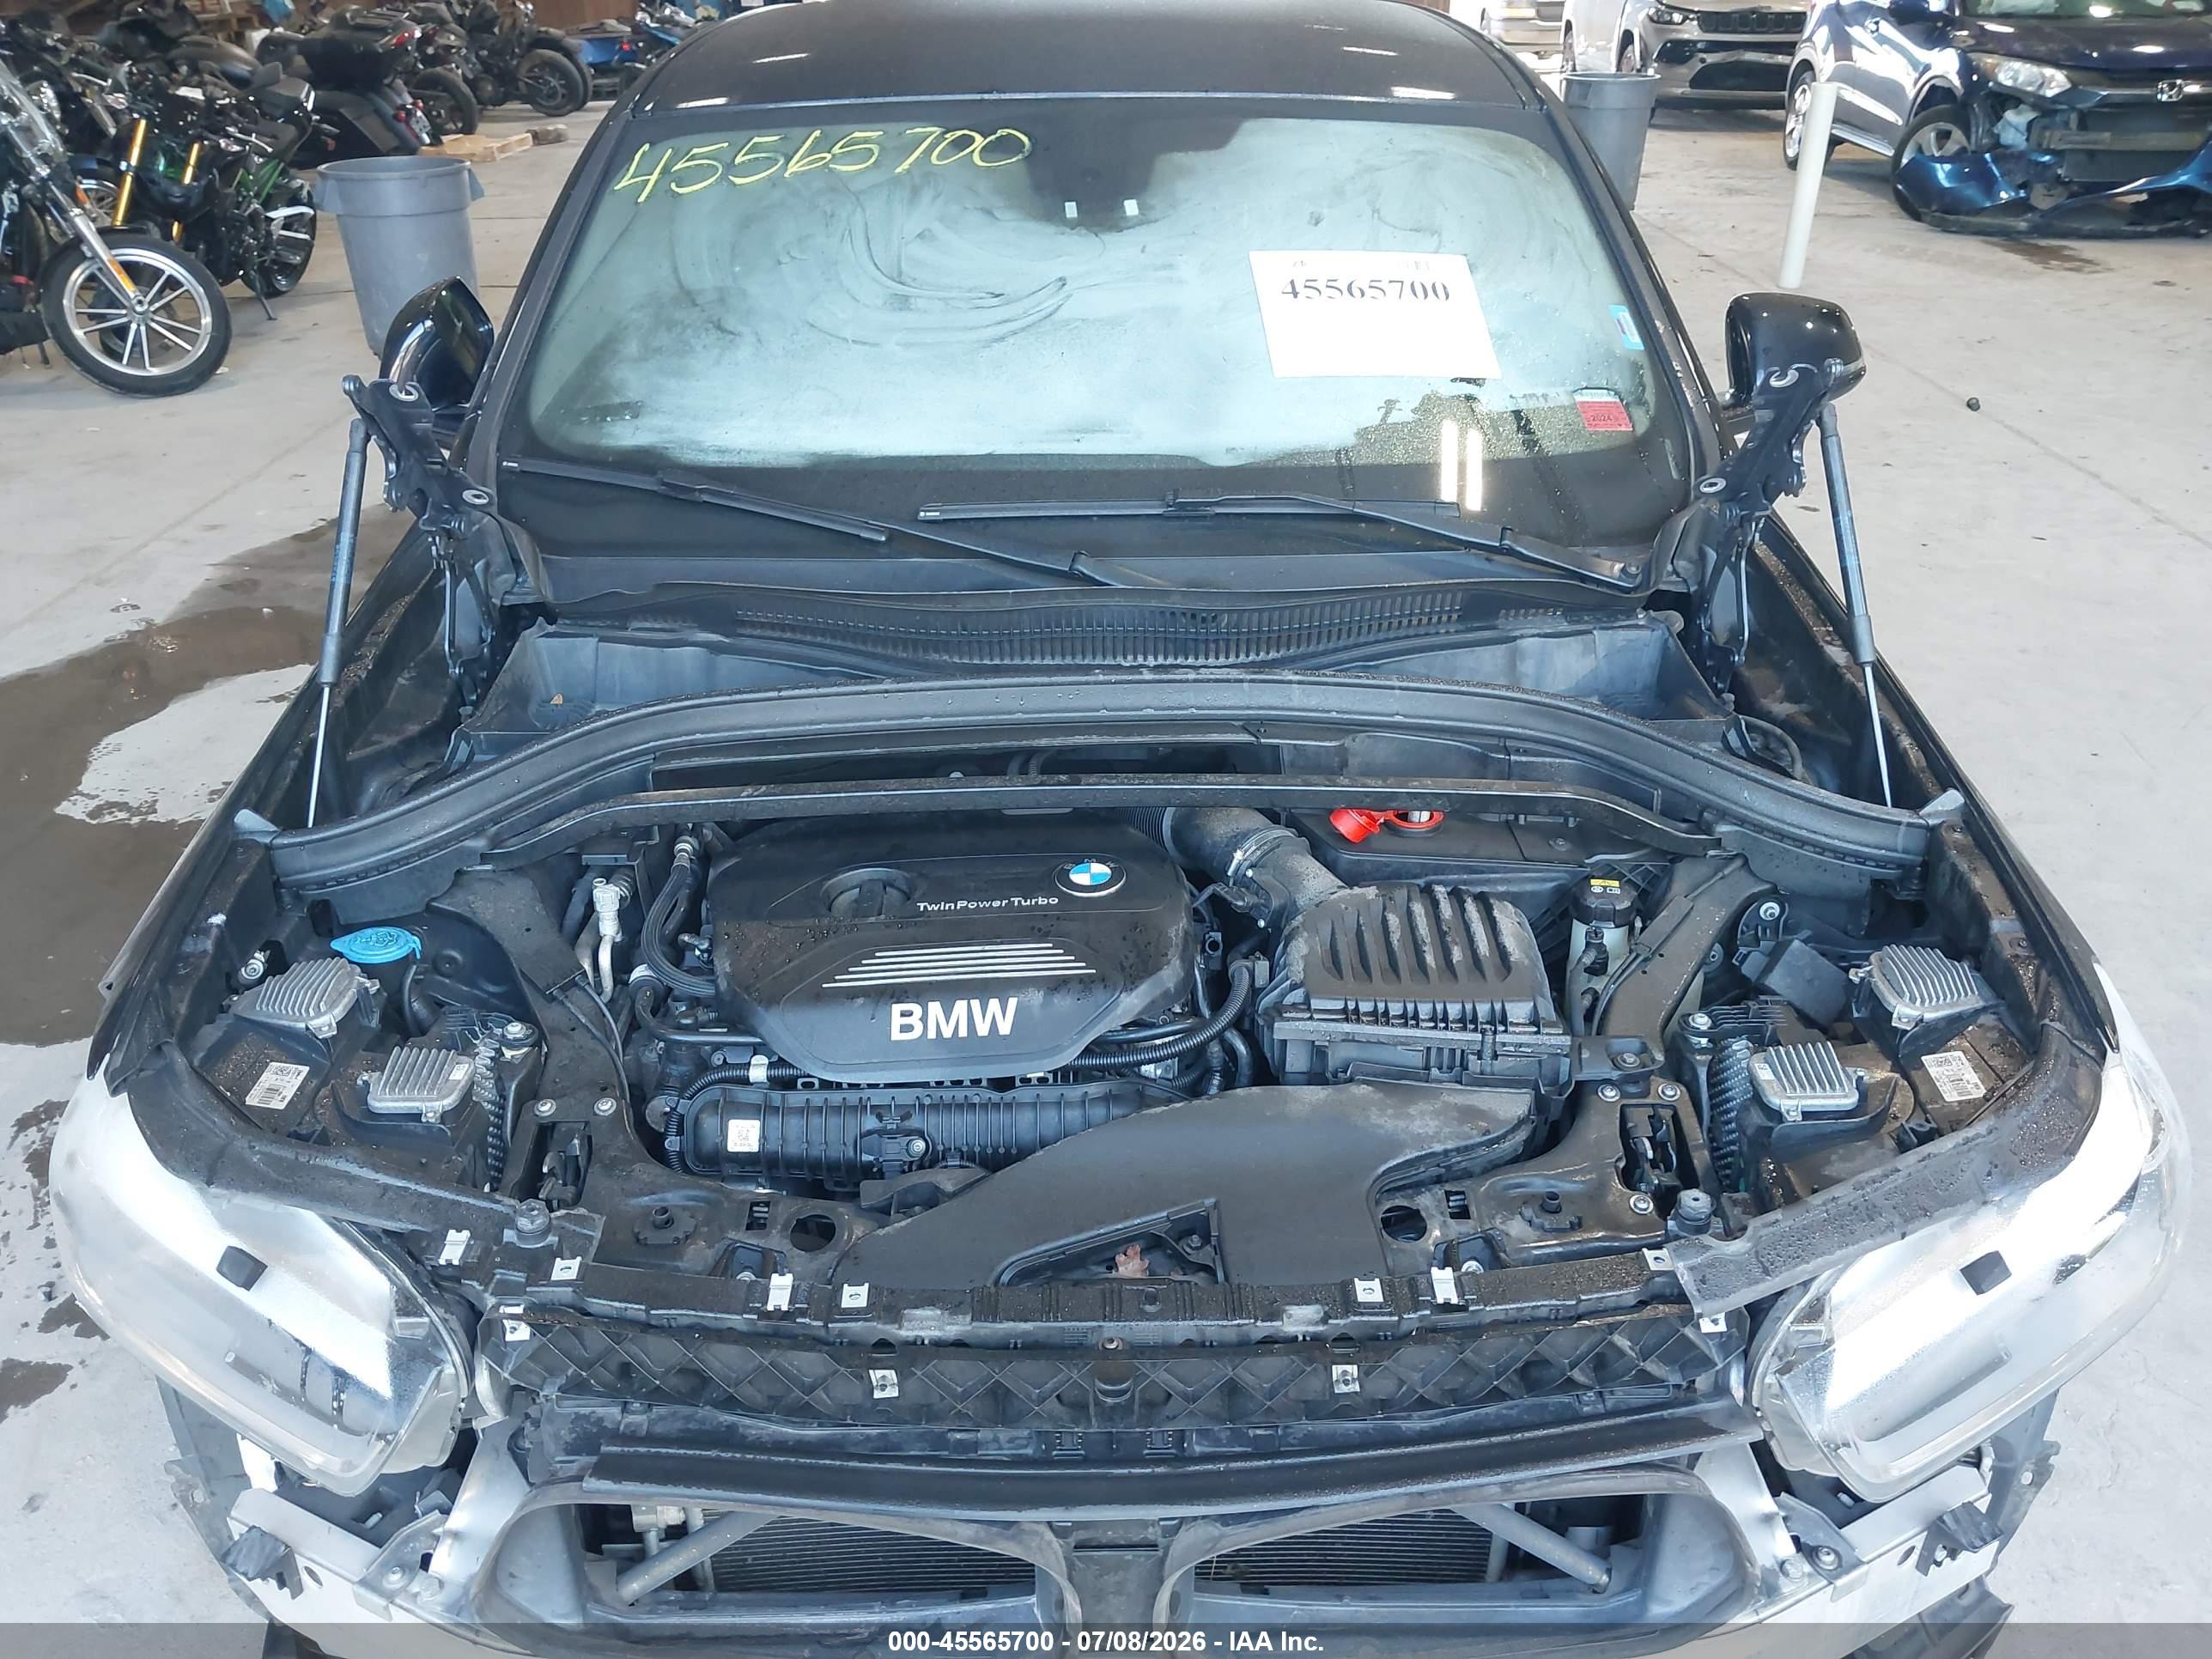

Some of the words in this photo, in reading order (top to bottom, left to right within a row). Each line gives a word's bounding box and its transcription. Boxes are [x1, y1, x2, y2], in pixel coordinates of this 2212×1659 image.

[613, 126, 1031, 204] 45565700
[1281, 278, 1450, 301] 45565700
[1010, 896, 1059, 907] Turbo
[890, 996, 1018, 1042] BMW
